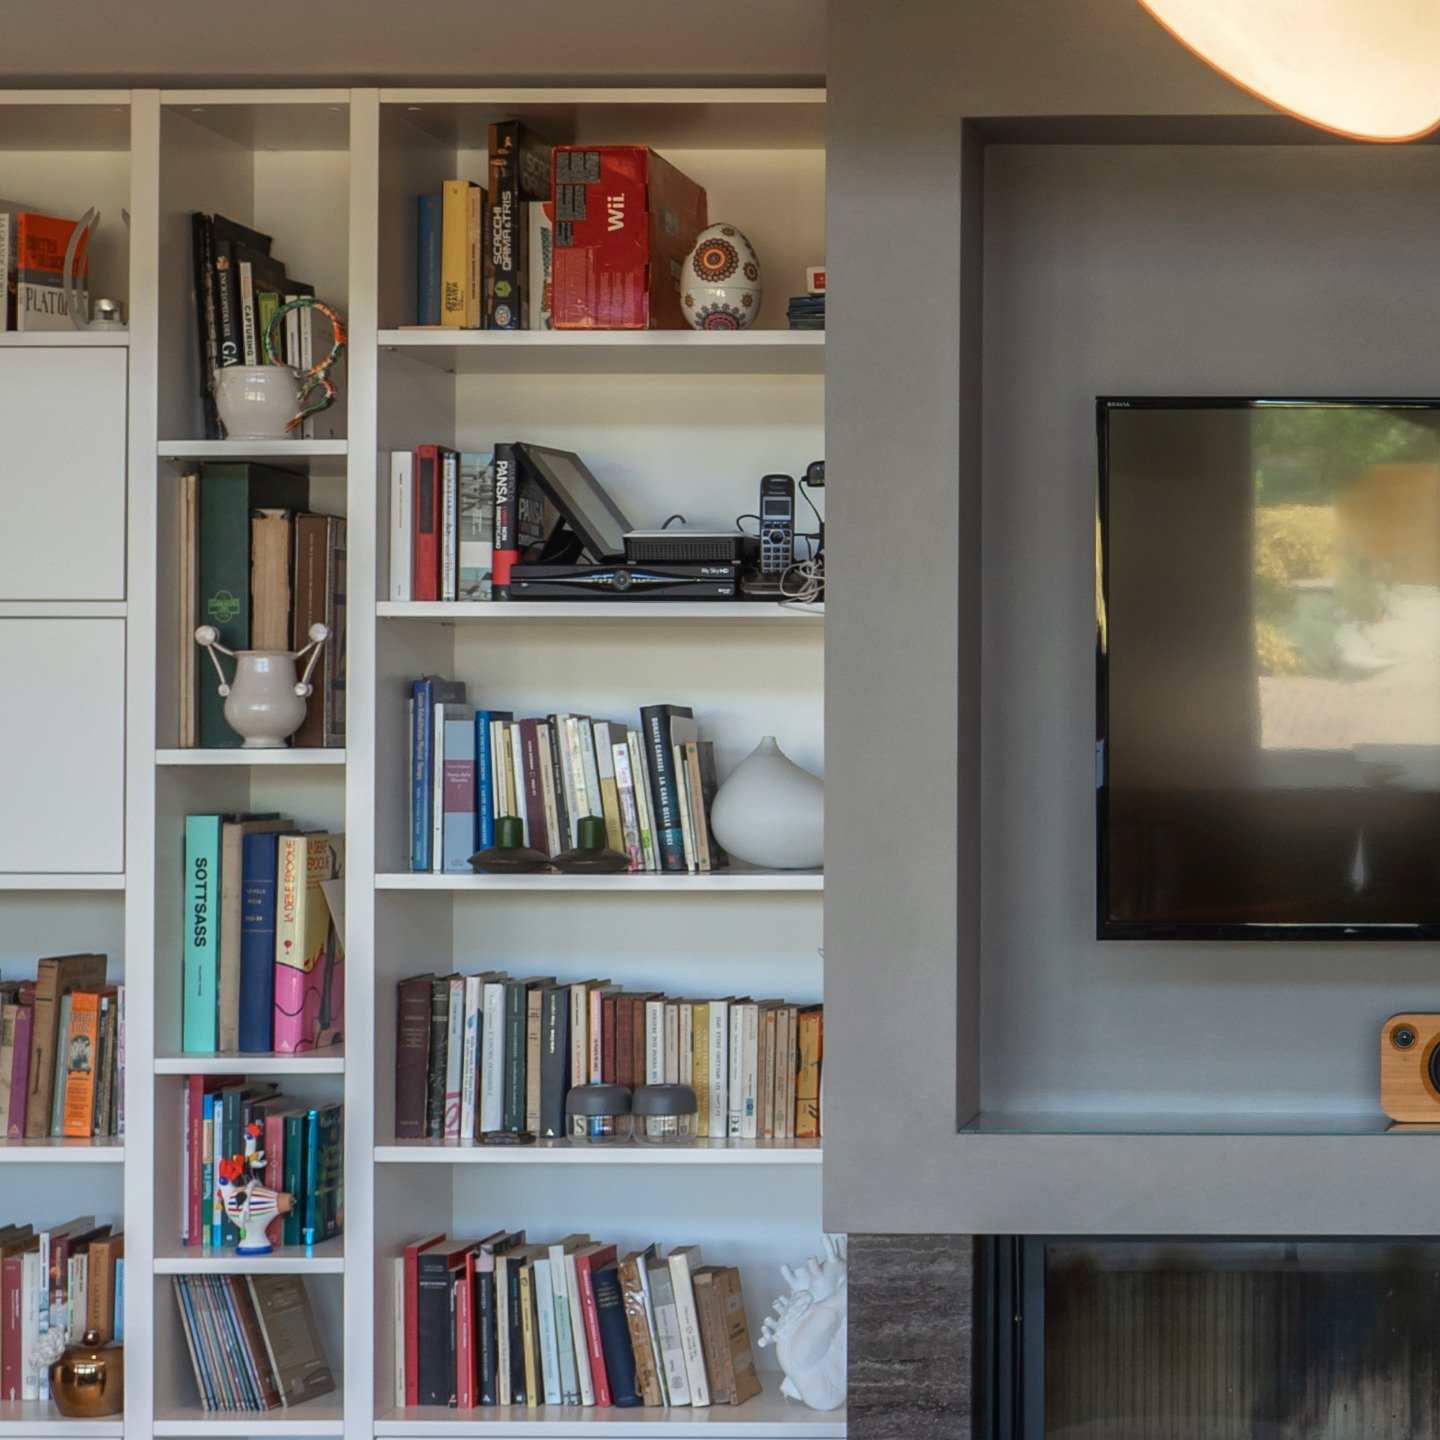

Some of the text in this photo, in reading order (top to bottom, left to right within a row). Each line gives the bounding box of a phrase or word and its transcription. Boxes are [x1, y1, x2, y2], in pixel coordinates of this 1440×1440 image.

[493, 206, 503, 265] SCACCHI
[219, 273, 230, 322] ENCICLOPEDIA
[244, 305, 255, 357] CAPTURING
[496, 460, 508, 504] PANSA
[651, 717, 661, 744] DONATO
[655, 744, 665, 773] CARRISI
[660, 787, 669, 806] CASA
[662, 807, 672, 828] DELLE
[664, 829, 673, 846] VOCI
[194, 857, 208, 948] SOTTSASS
